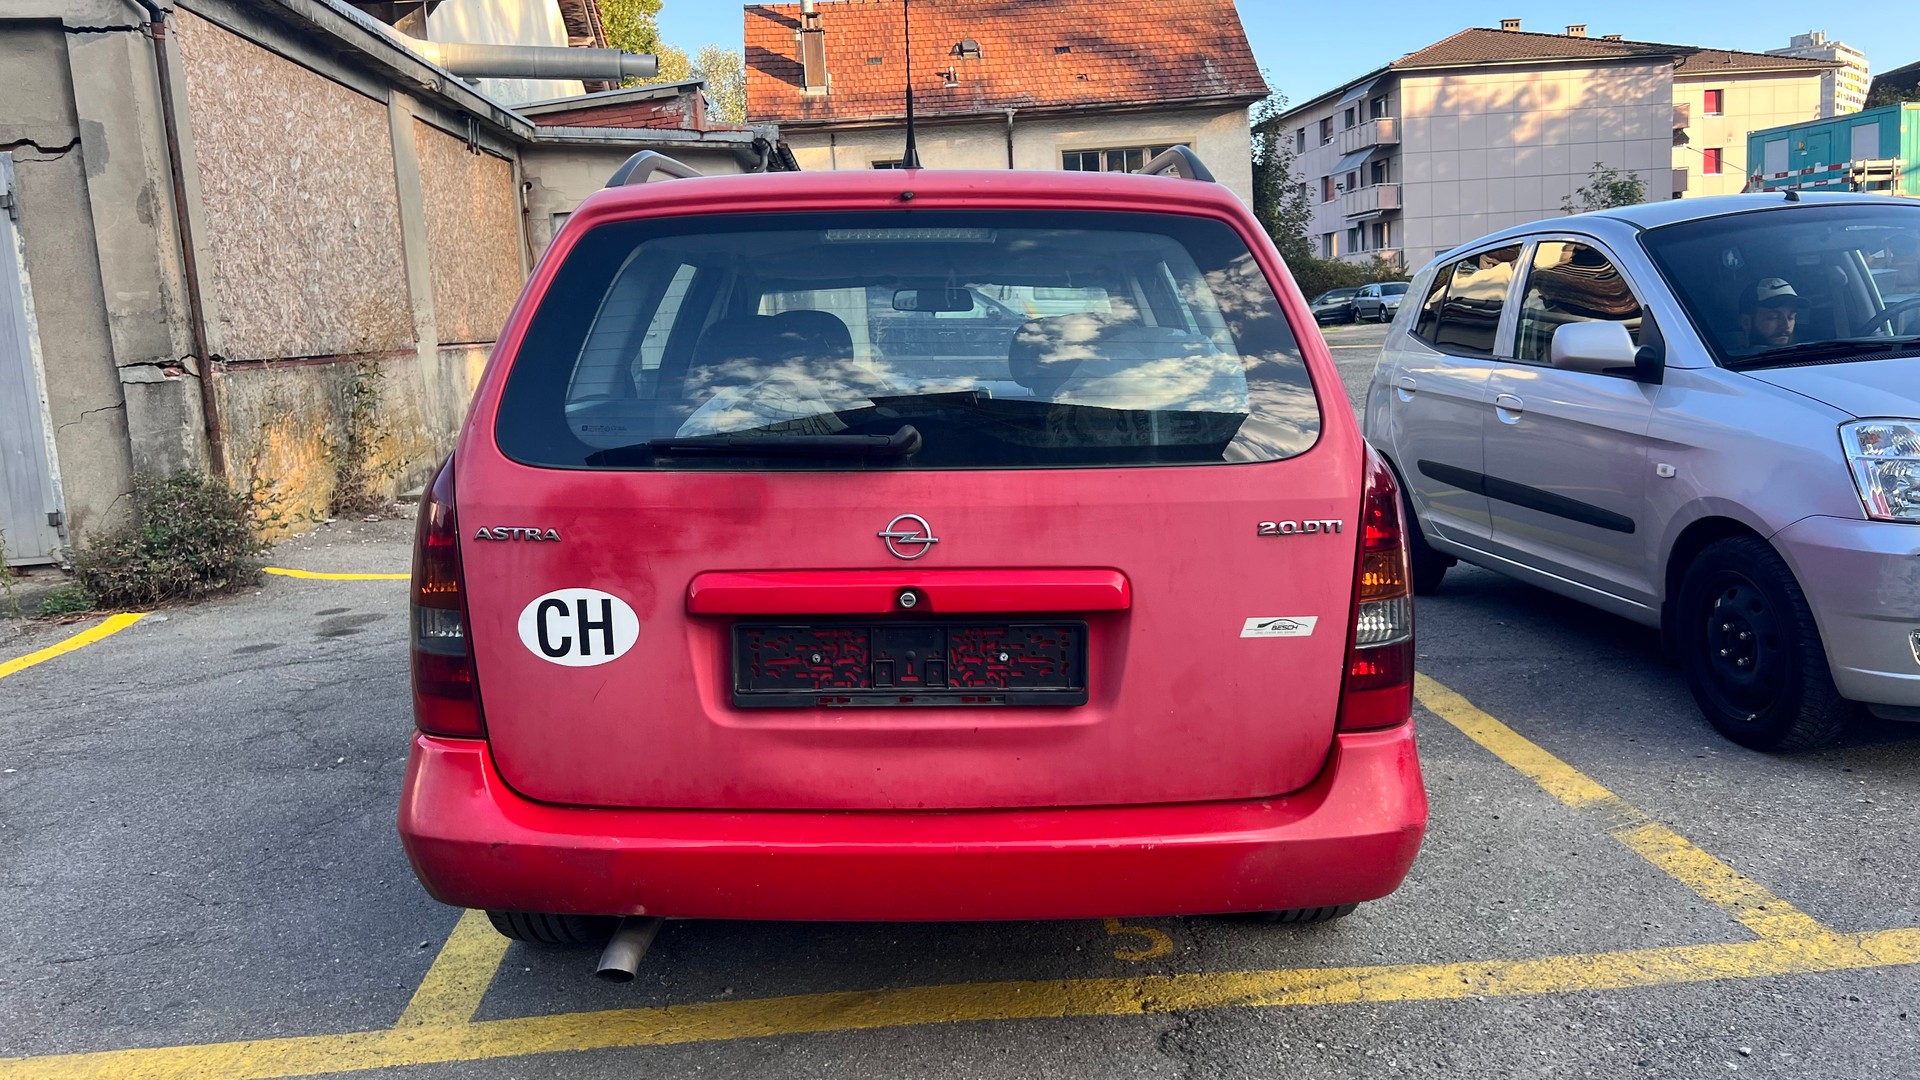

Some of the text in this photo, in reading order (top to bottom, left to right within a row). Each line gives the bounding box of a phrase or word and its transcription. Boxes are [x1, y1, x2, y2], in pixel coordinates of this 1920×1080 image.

[474, 526, 562, 542] ASTRA
[537, 598, 615, 658] CH
[1103, 916, 1174, 961] 5
